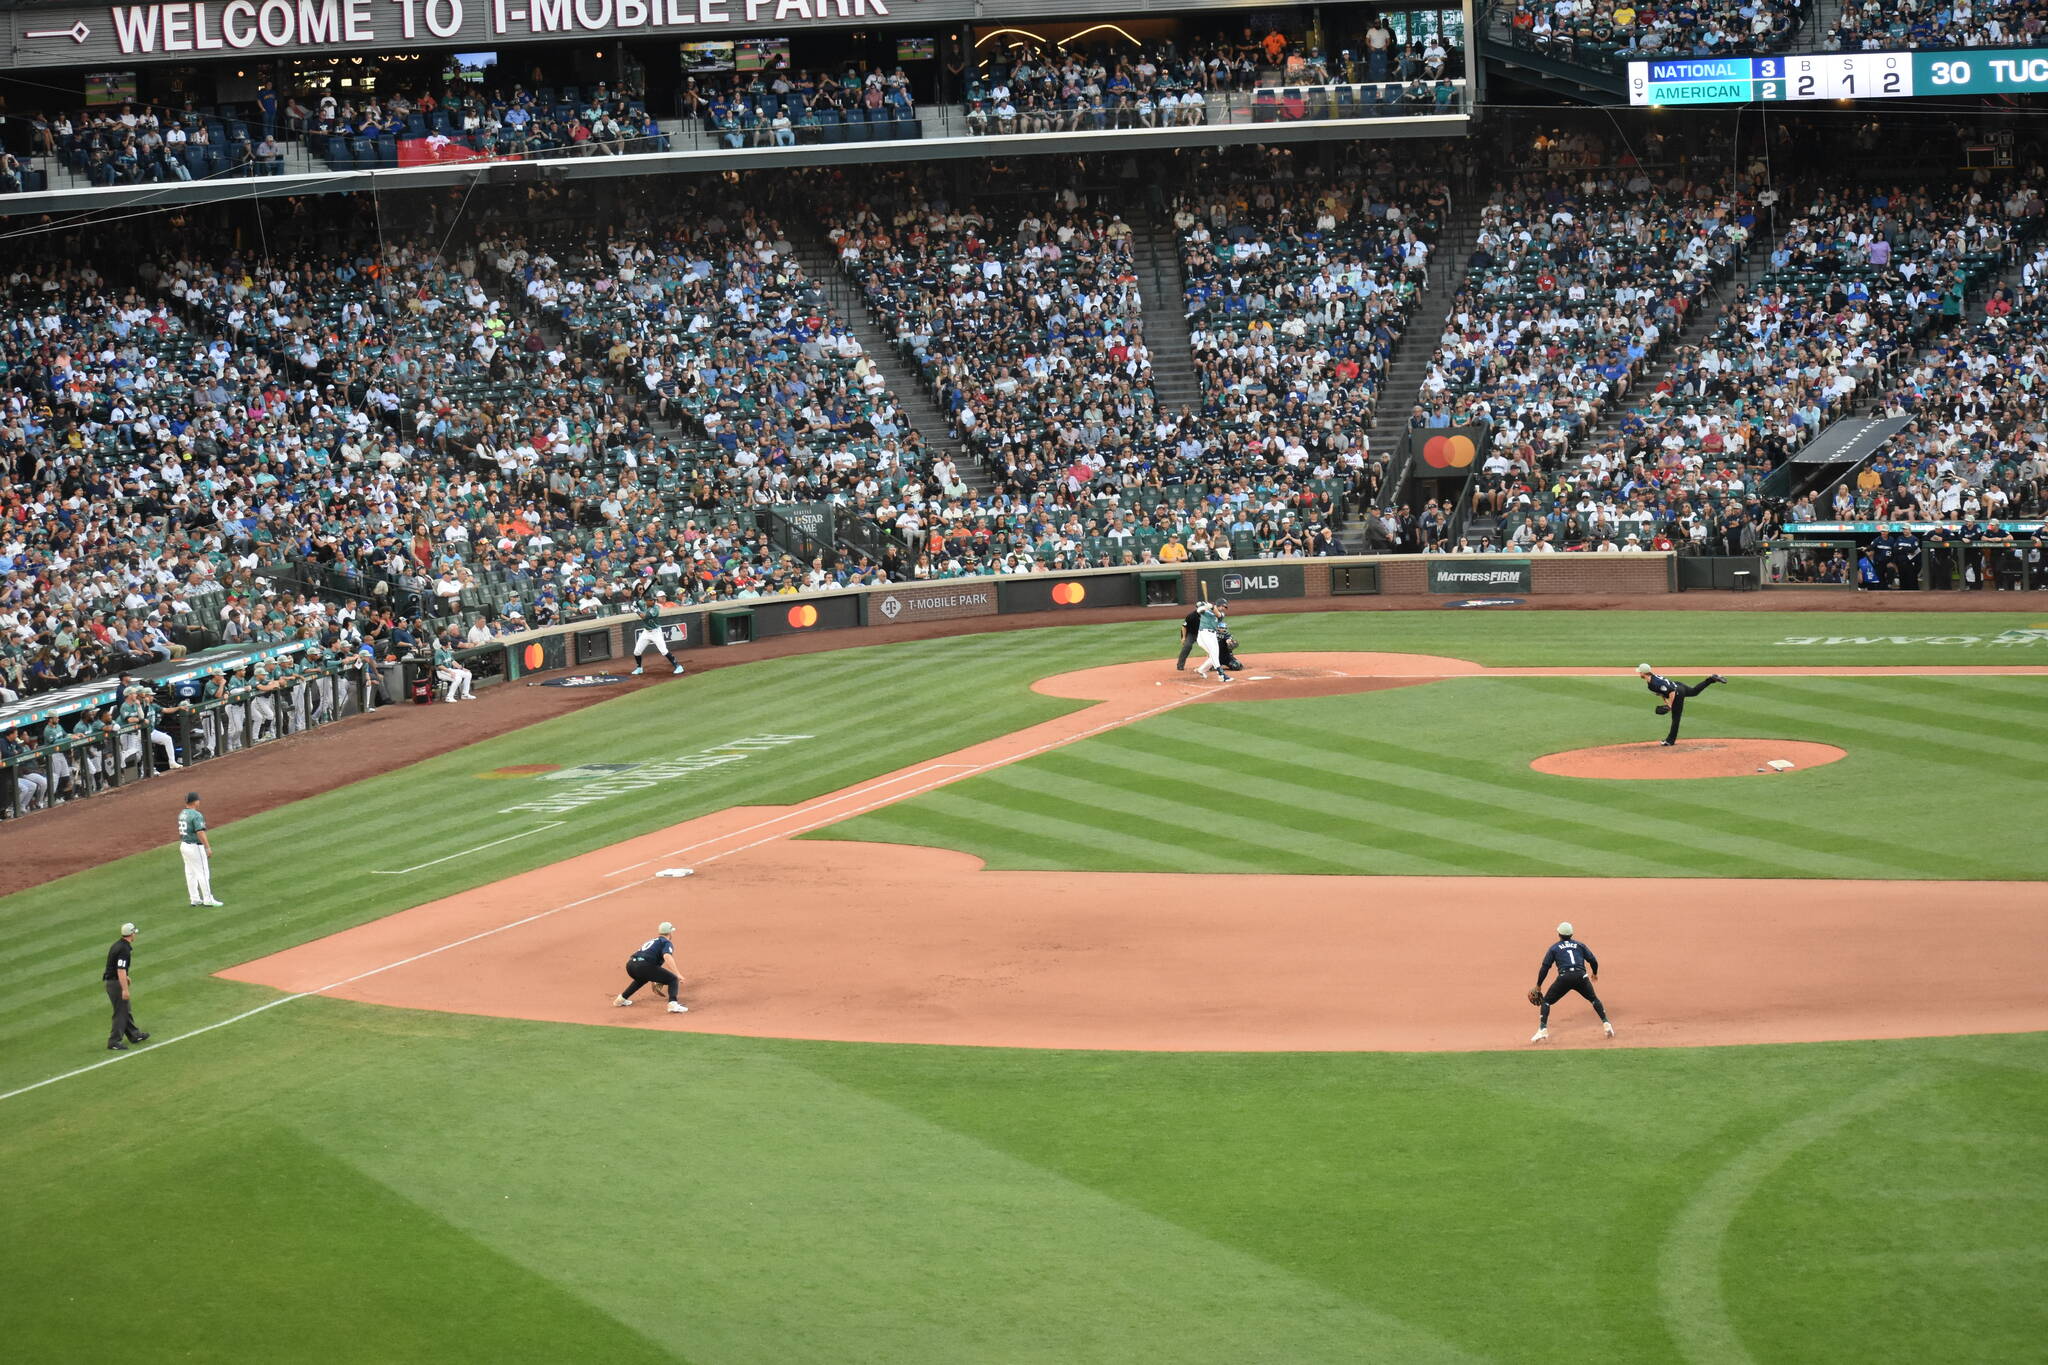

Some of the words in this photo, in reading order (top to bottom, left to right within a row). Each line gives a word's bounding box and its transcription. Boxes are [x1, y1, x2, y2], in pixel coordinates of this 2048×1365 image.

[112, 0, 374, 53] WELCOME
[395, 0, 463, 39] TO
[1654, 64, 1737, 79] NATIONAL
[1761, 60, 1776, 77] 3
[1801, 61, 1811, 71] B
[1843, 58, 1854, 70] S
[1931, 61, 1971, 84] 30
[1989, 59, 2048, 83] TUC
[1633, 78, 1644, 89] 9
[1655, 85, 1740, 99] AMERICAN
[1762, 82, 1777, 98] 2
[1798, 75, 1815, 96] 2
[1841, 74, 1855, 94] 1
[1883, 72, 1900, 93] 2
[1244, 576, 1280, 590] MLB
[908, 596, 957, 610] T-MOBILE
[959, 593, 988, 606] PARK
[1566, 949, 1575, 965] 1
